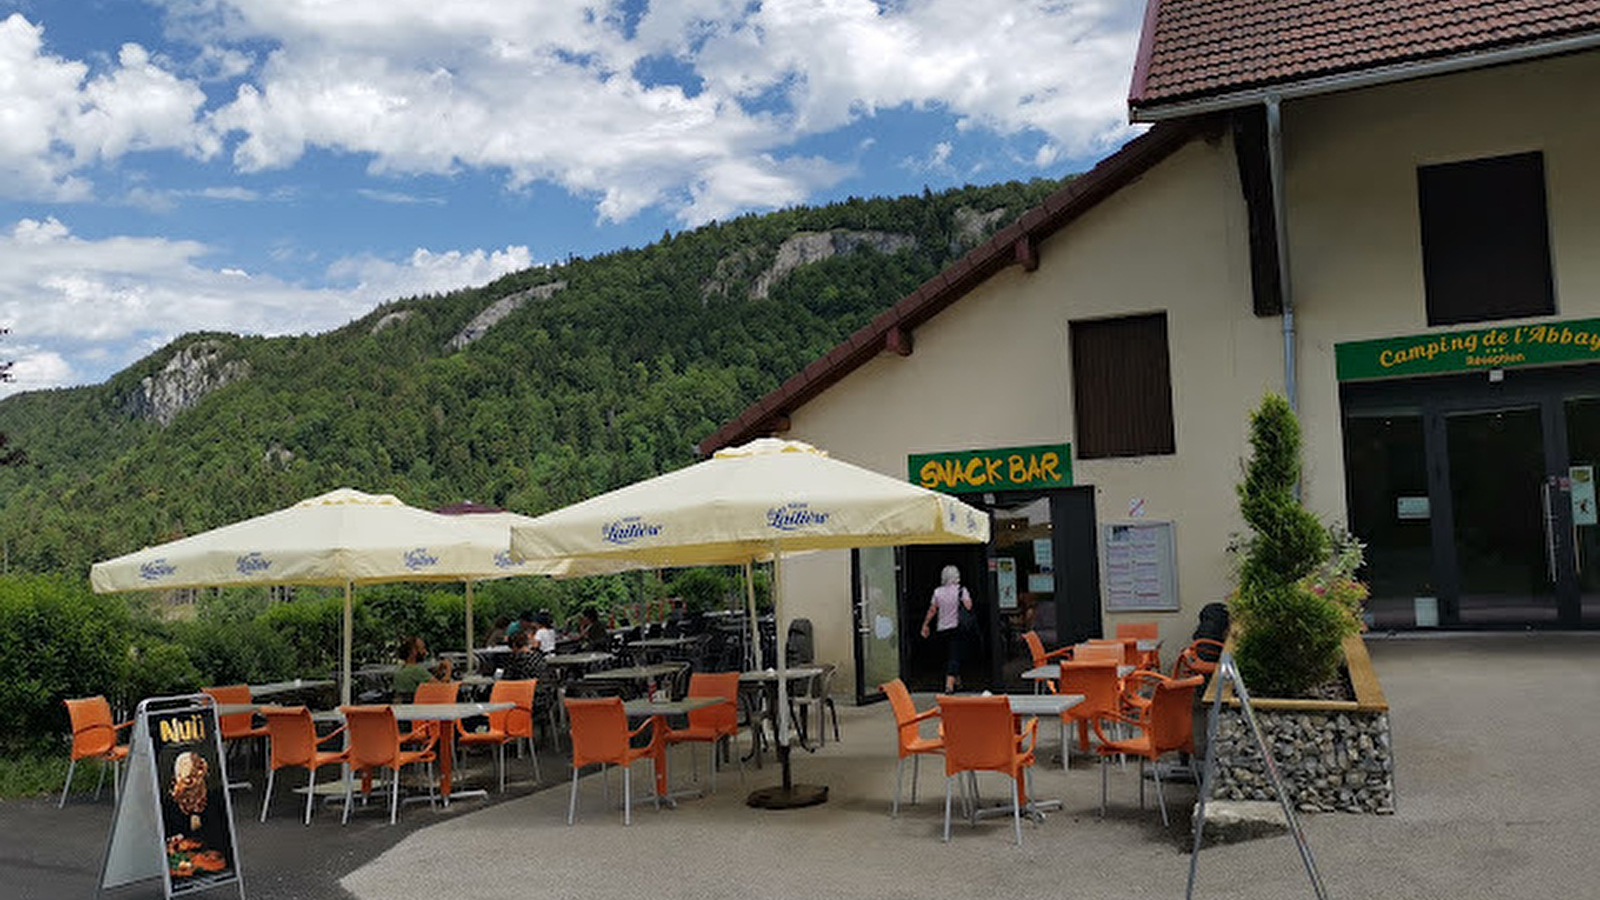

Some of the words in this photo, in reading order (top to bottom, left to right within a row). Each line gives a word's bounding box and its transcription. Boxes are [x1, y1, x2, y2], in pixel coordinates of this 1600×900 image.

[1379, 334, 1478, 368] Camping
[1483, 329, 1510, 346] de
[920, 457, 1003, 488] SNACK
[1008, 452, 1062, 483] BAR
